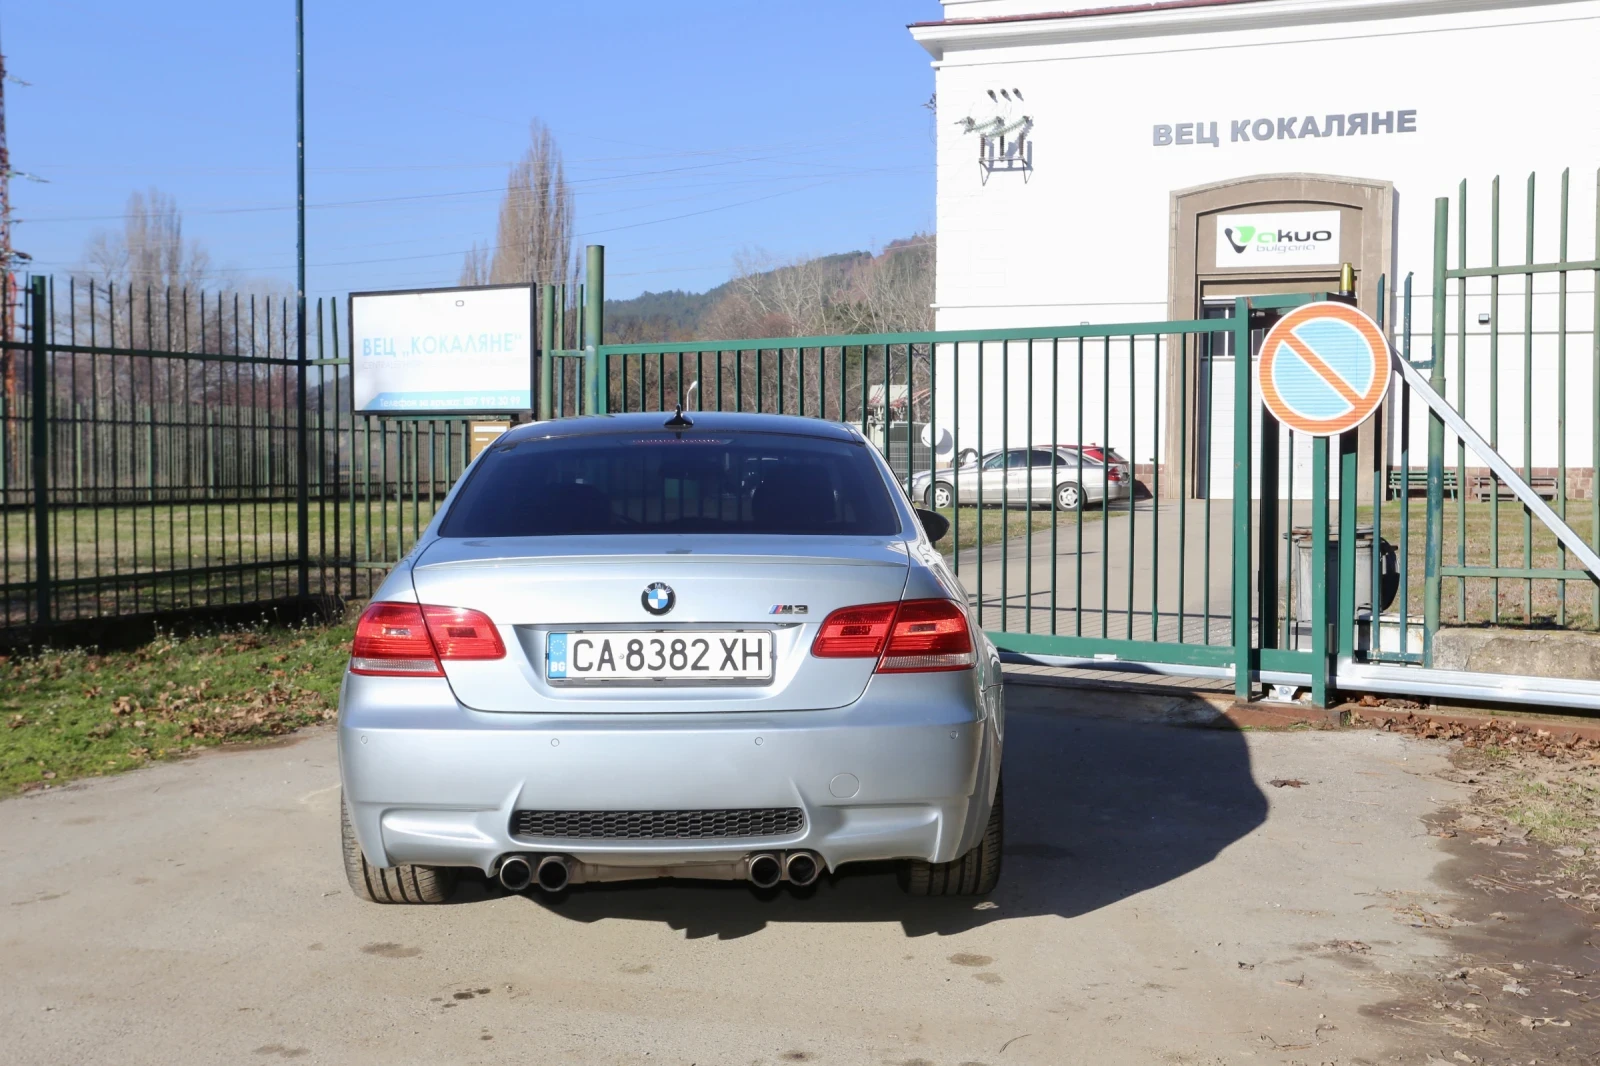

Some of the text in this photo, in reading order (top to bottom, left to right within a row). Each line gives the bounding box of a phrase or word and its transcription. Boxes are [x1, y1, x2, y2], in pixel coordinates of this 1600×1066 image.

[1153, 109, 1417, 147] ВЕЦ КОКАЛЯНЕ
[1257, 229, 1332, 243] akuo
[1256, 243, 1316, 254] bulgaria
[363, 337, 396, 358] ВЕЦ
[769, 605, 808, 614] M3
[573, 638, 763, 672] CA 8382 XH
[550, 661, 566, 673] BG
